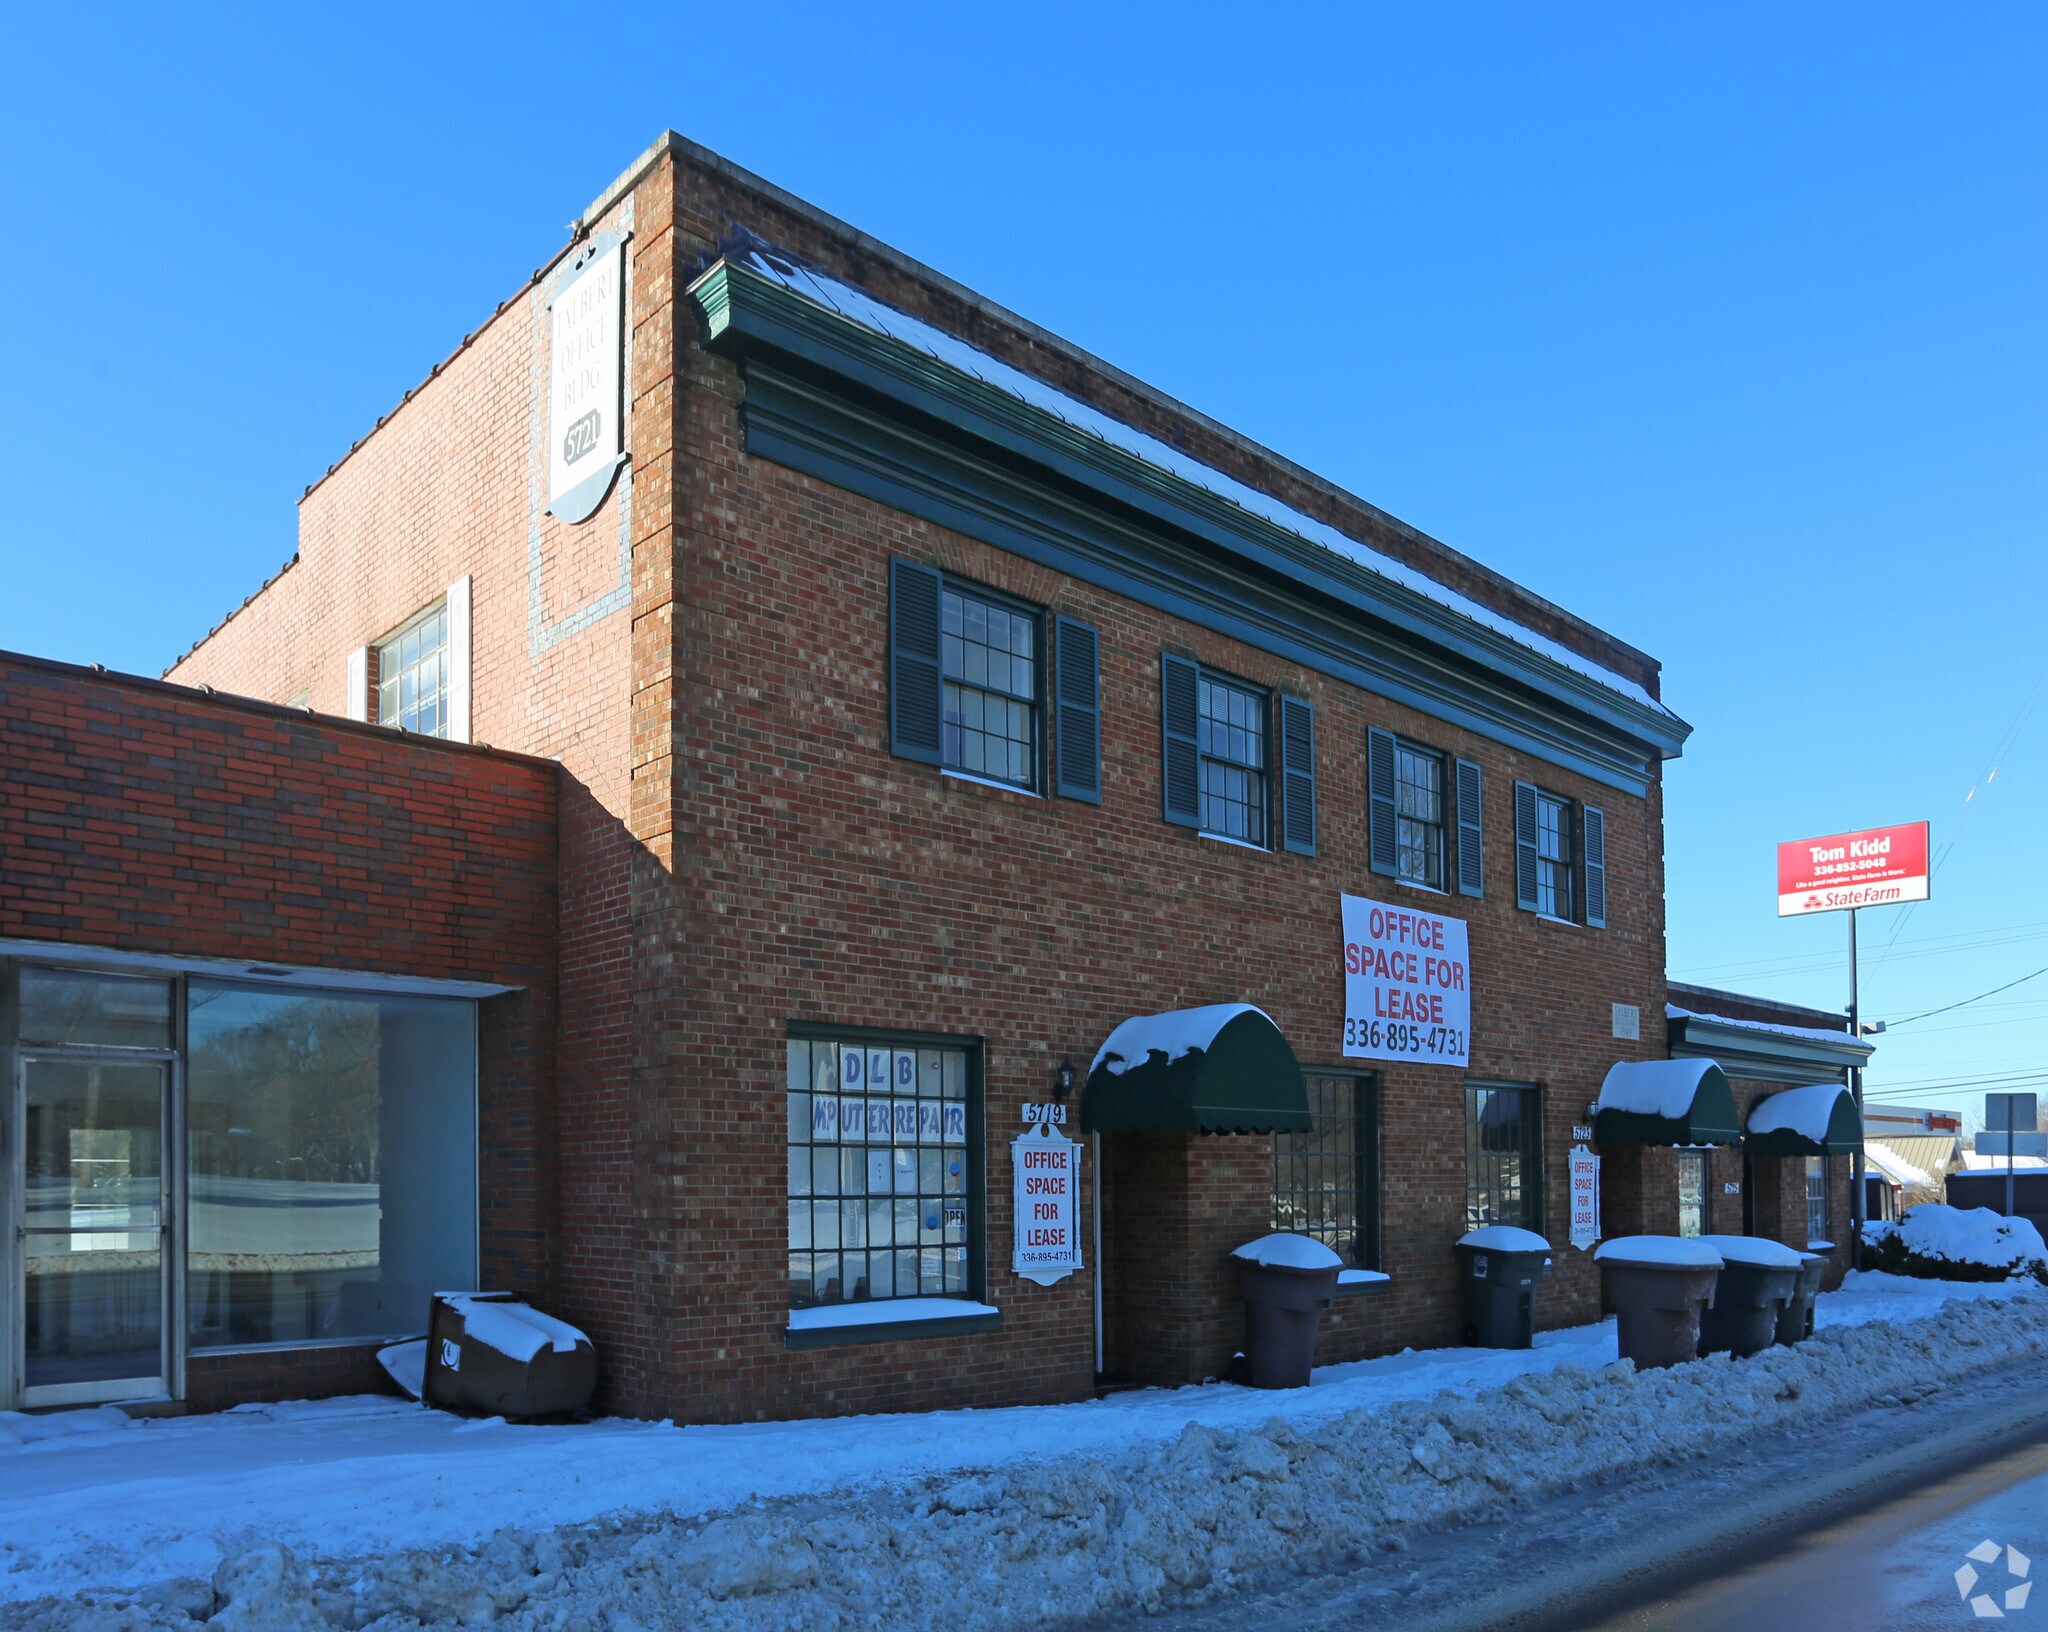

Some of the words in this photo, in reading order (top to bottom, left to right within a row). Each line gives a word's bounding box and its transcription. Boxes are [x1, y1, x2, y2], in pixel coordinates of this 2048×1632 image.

[557, 265, 615, 338] TALBERT
[561, 312, 608, 373] OFFICE
[563, 360, 604, 411] BLDG.
[566, 415, 598, 462] 5721
[1809, 846, 1845, 863] Tom
[1850, 836, 1890, 857] Kidd
[1814, 857, 1886, 876] 336-852-5048
[1369, 908, 1445, 950] OFFICE
[1345, 942, 1418, 984] SPACE
[1425, 956, 1464, 991] FOR
[1374, 986, 1443, 1024] LEASE
[1346, 1017, 1465, 1056] 336-895-4731
[895, 1104, 964, 1136] REPAIR
[1027, 1103, 1062, 1123] 5719
[1024, 1151, 1067, 1169] OFFICE
[1574, 1161, 1593, 1173] OFFICE
[1026, 1177, 1066, 1195] SPACE
[1574, 1178, 1592, 1190] SPACE
[1577, 1195, 1589, 1207] FOR
[944, 1210, 966, 1226] OPEN
[1034, 1203, 1058, 1220] FOR
[1574, 1212, 1592, 1223] LEASE
[1027, 1228, 1066, 1246] LEASE
[1021, 1251, 1072, 1262] 336-895-4731
